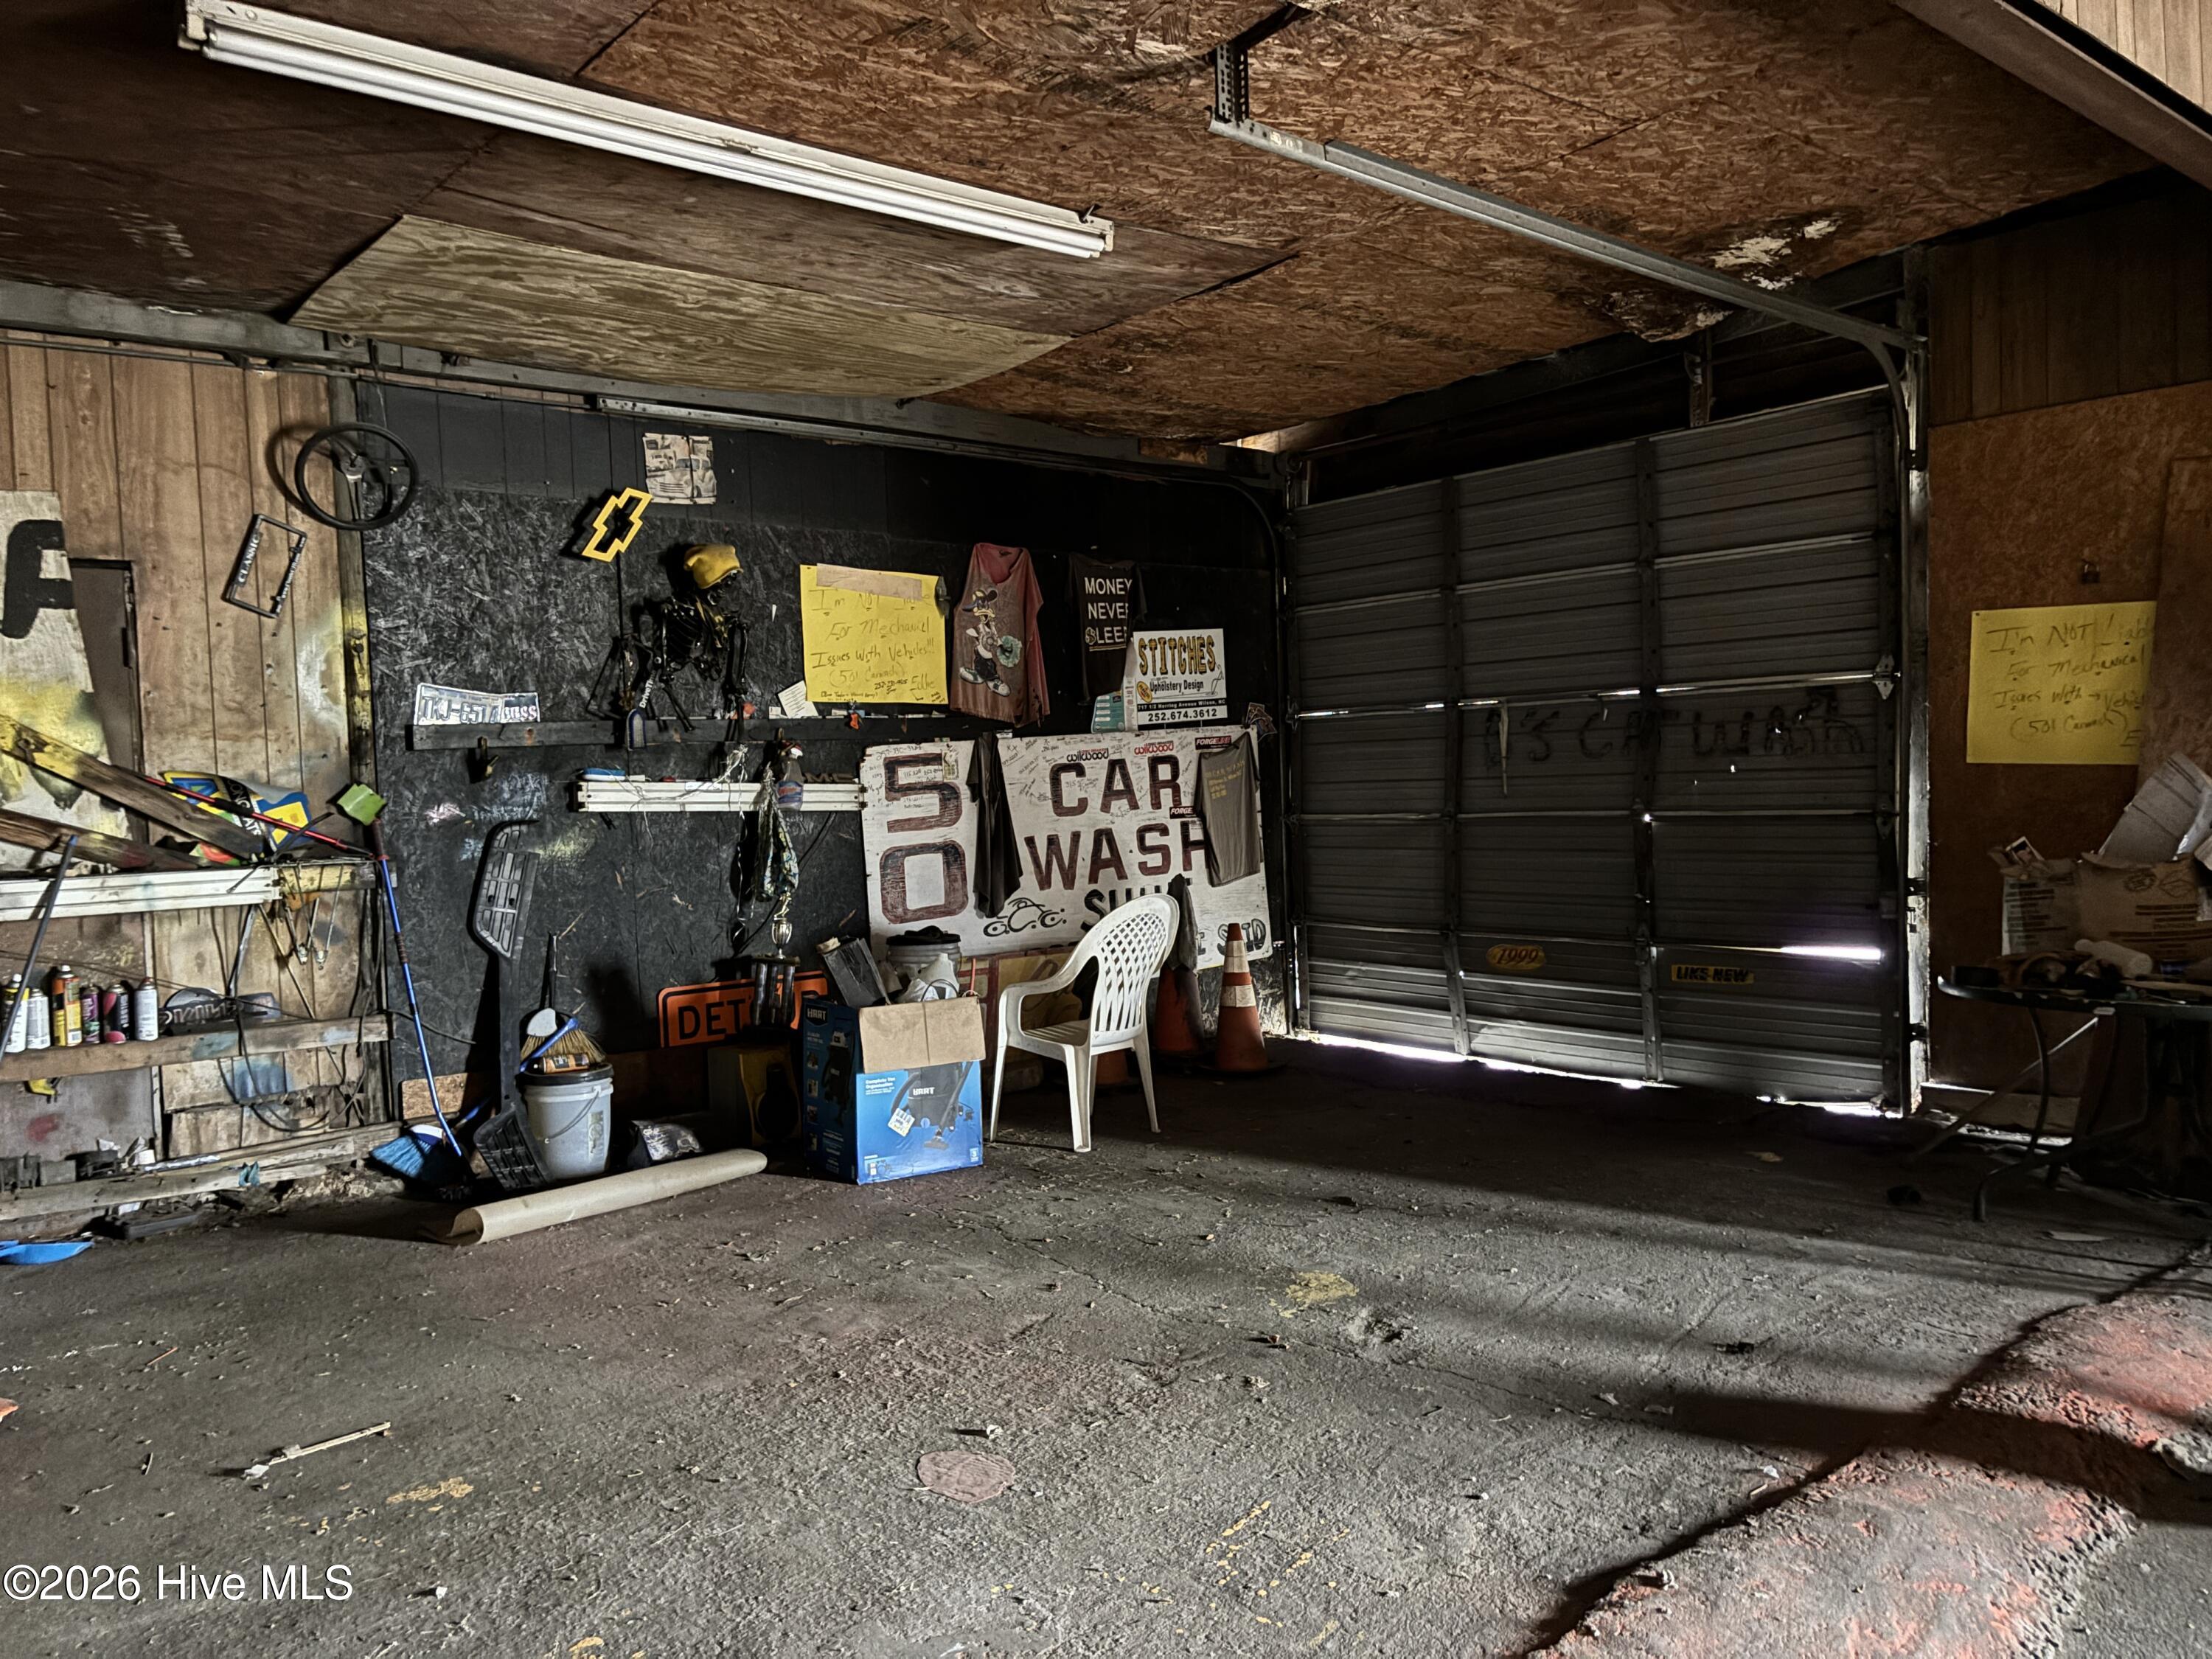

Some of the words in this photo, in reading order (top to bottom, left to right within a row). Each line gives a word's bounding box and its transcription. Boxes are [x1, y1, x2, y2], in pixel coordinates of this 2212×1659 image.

[1084, 577, 1133, 595] MONEY
[2047, 623, 2094, 646] NOT
[811, 652, 850, 669] Issues
[1138, 635, 1217, 677] STITCHES
[1150, 681, 1182, 694] Upholstery
[1183, 678, 1204, 692] Design
[1148, 708, 1217, 722] 252.674.3612
[1066, 748, 1109, 762] wilwood
[1134, 742, 1174, 756] wilwood
[1048, 754, 1183, 818] CAR
[227, 779, 263, 836] CONGATS
[1170, 807, 1194, 815] FORGE
[1023, 820, 1210, 891] WASH
[1497, 947, 1539, 965] 1999
[807, 1008, 827, 1021] HART
[913, 1087, 935, 1096] HART
